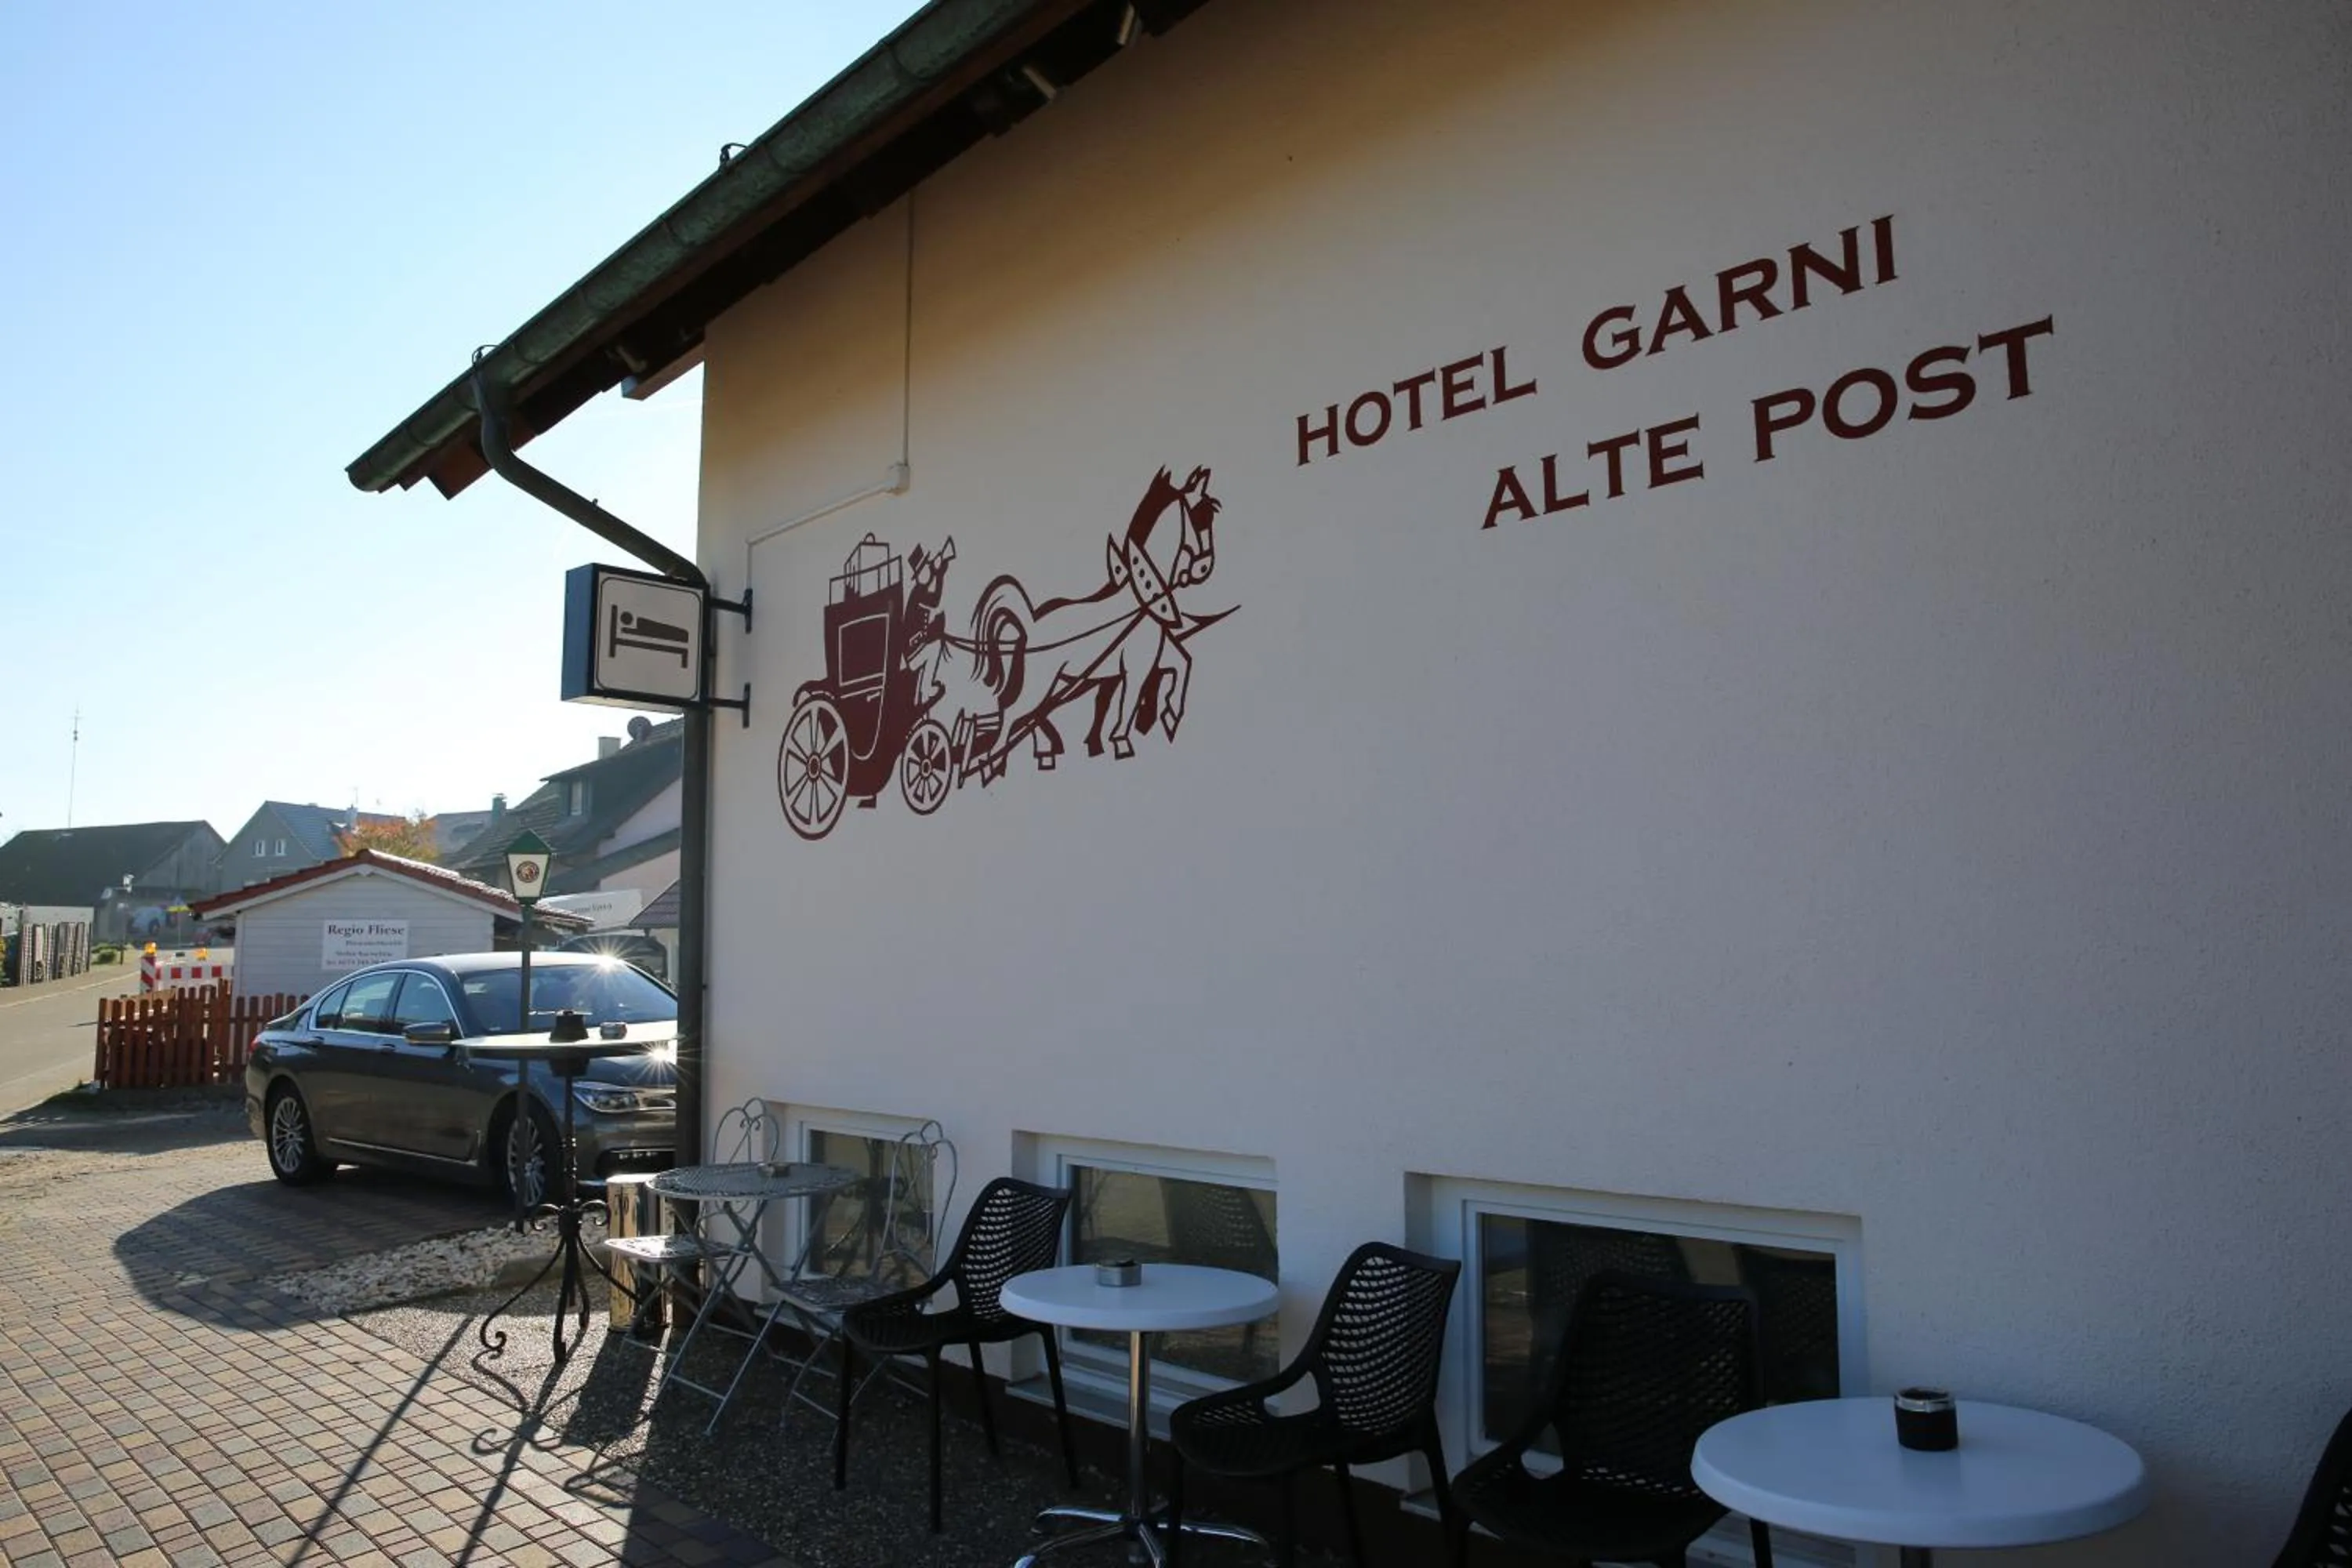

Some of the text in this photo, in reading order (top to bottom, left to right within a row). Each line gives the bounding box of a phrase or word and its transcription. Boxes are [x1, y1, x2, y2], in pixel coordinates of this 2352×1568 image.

[1297, 214, 1899, 466] HOTEL GARNI
[1482, 314, 2054, 530] ALTE POST
[328, 924, 405, 938] Regio Fliese
